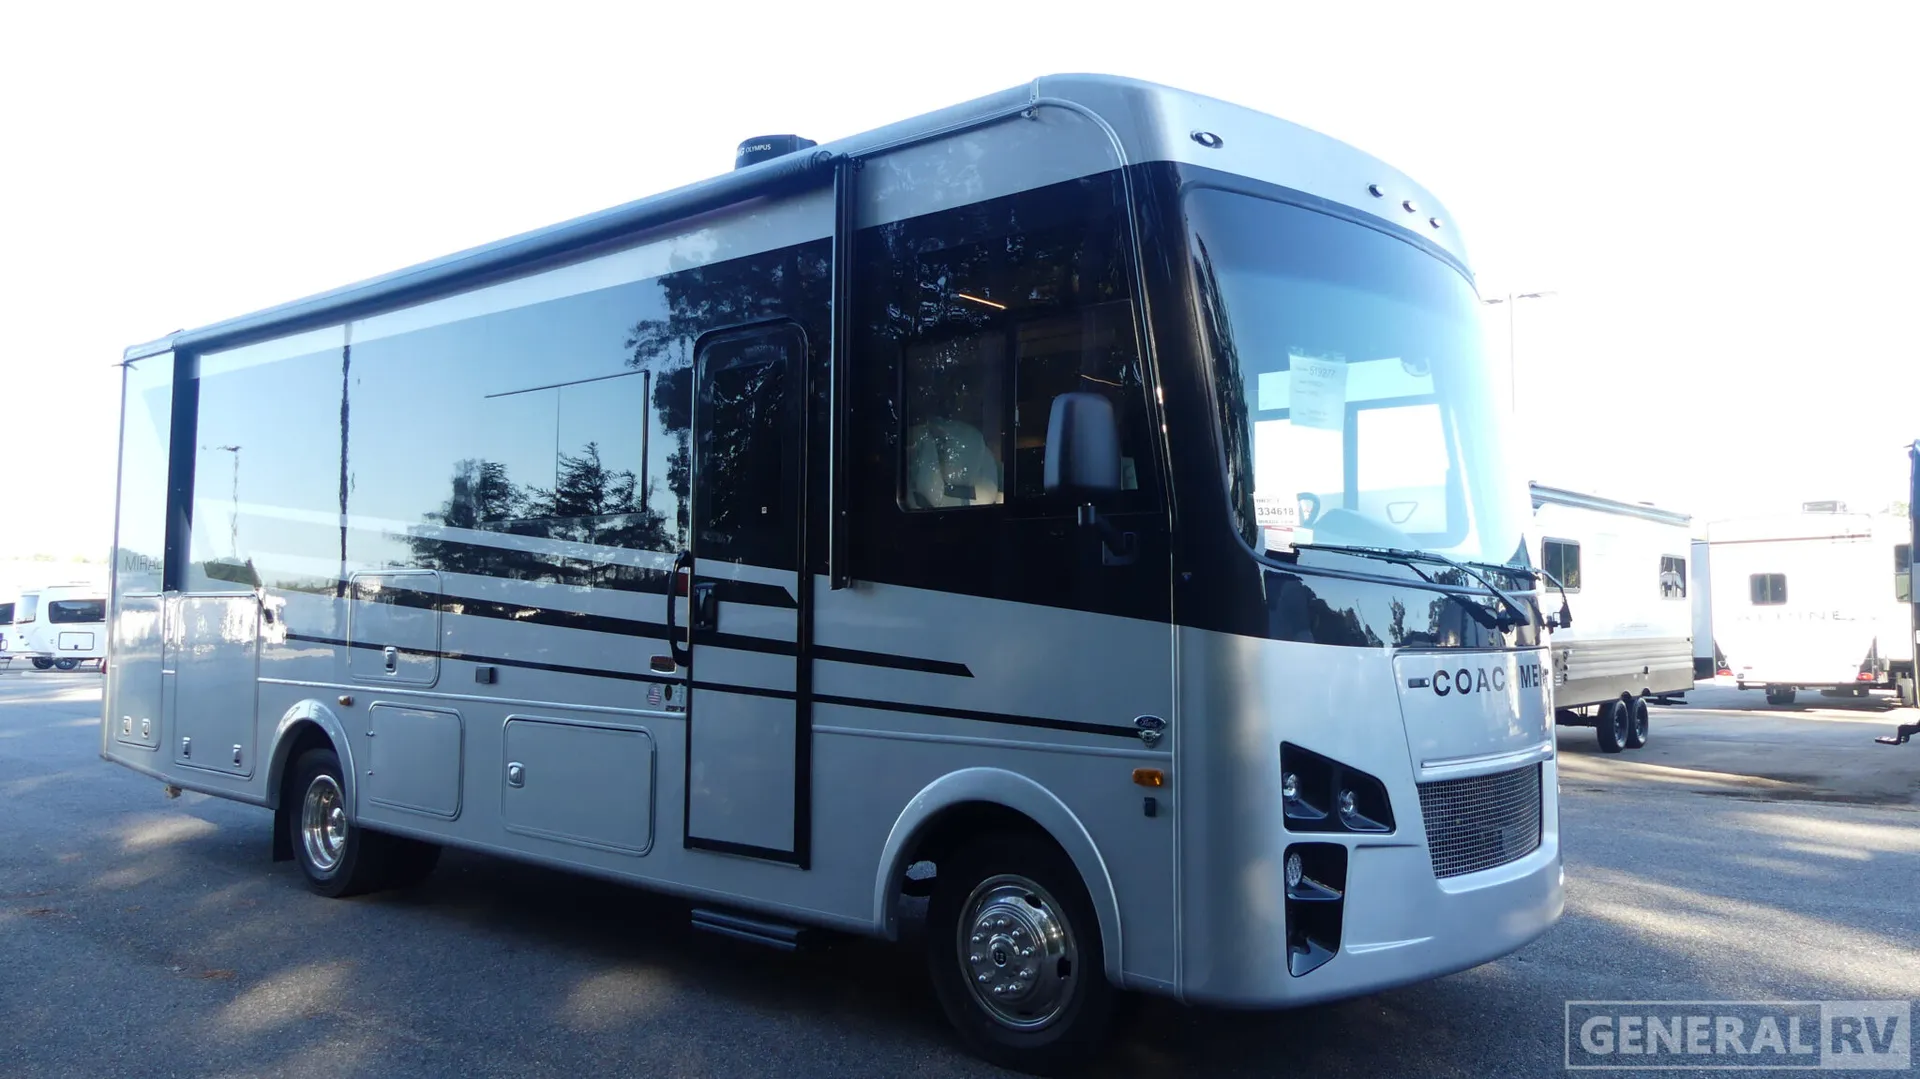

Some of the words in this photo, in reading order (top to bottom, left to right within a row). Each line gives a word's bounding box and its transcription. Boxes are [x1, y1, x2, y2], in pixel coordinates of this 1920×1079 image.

[745, 143, 771, 153] OLYMPUS
[1257, 507, 1294, 516] 334618
[1432, 664, 1545, 697] COACME
